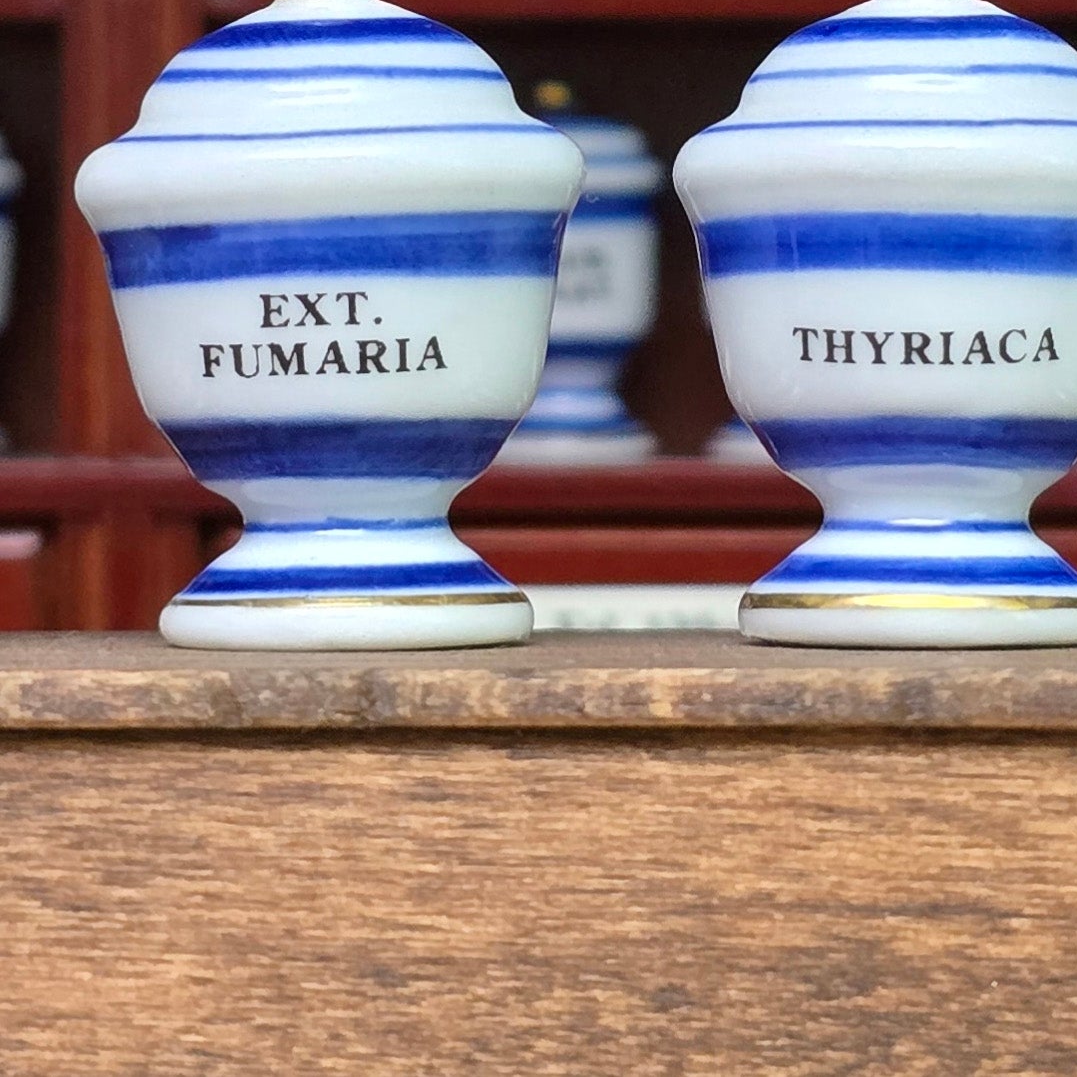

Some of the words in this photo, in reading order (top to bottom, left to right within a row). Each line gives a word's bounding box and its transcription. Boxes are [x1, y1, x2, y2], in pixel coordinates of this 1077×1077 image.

[259, 291, 383, 328] EXT.
[199, 335, 448, 379] FUMARIA
[792, 326, 1060, 365] THYRIACA
